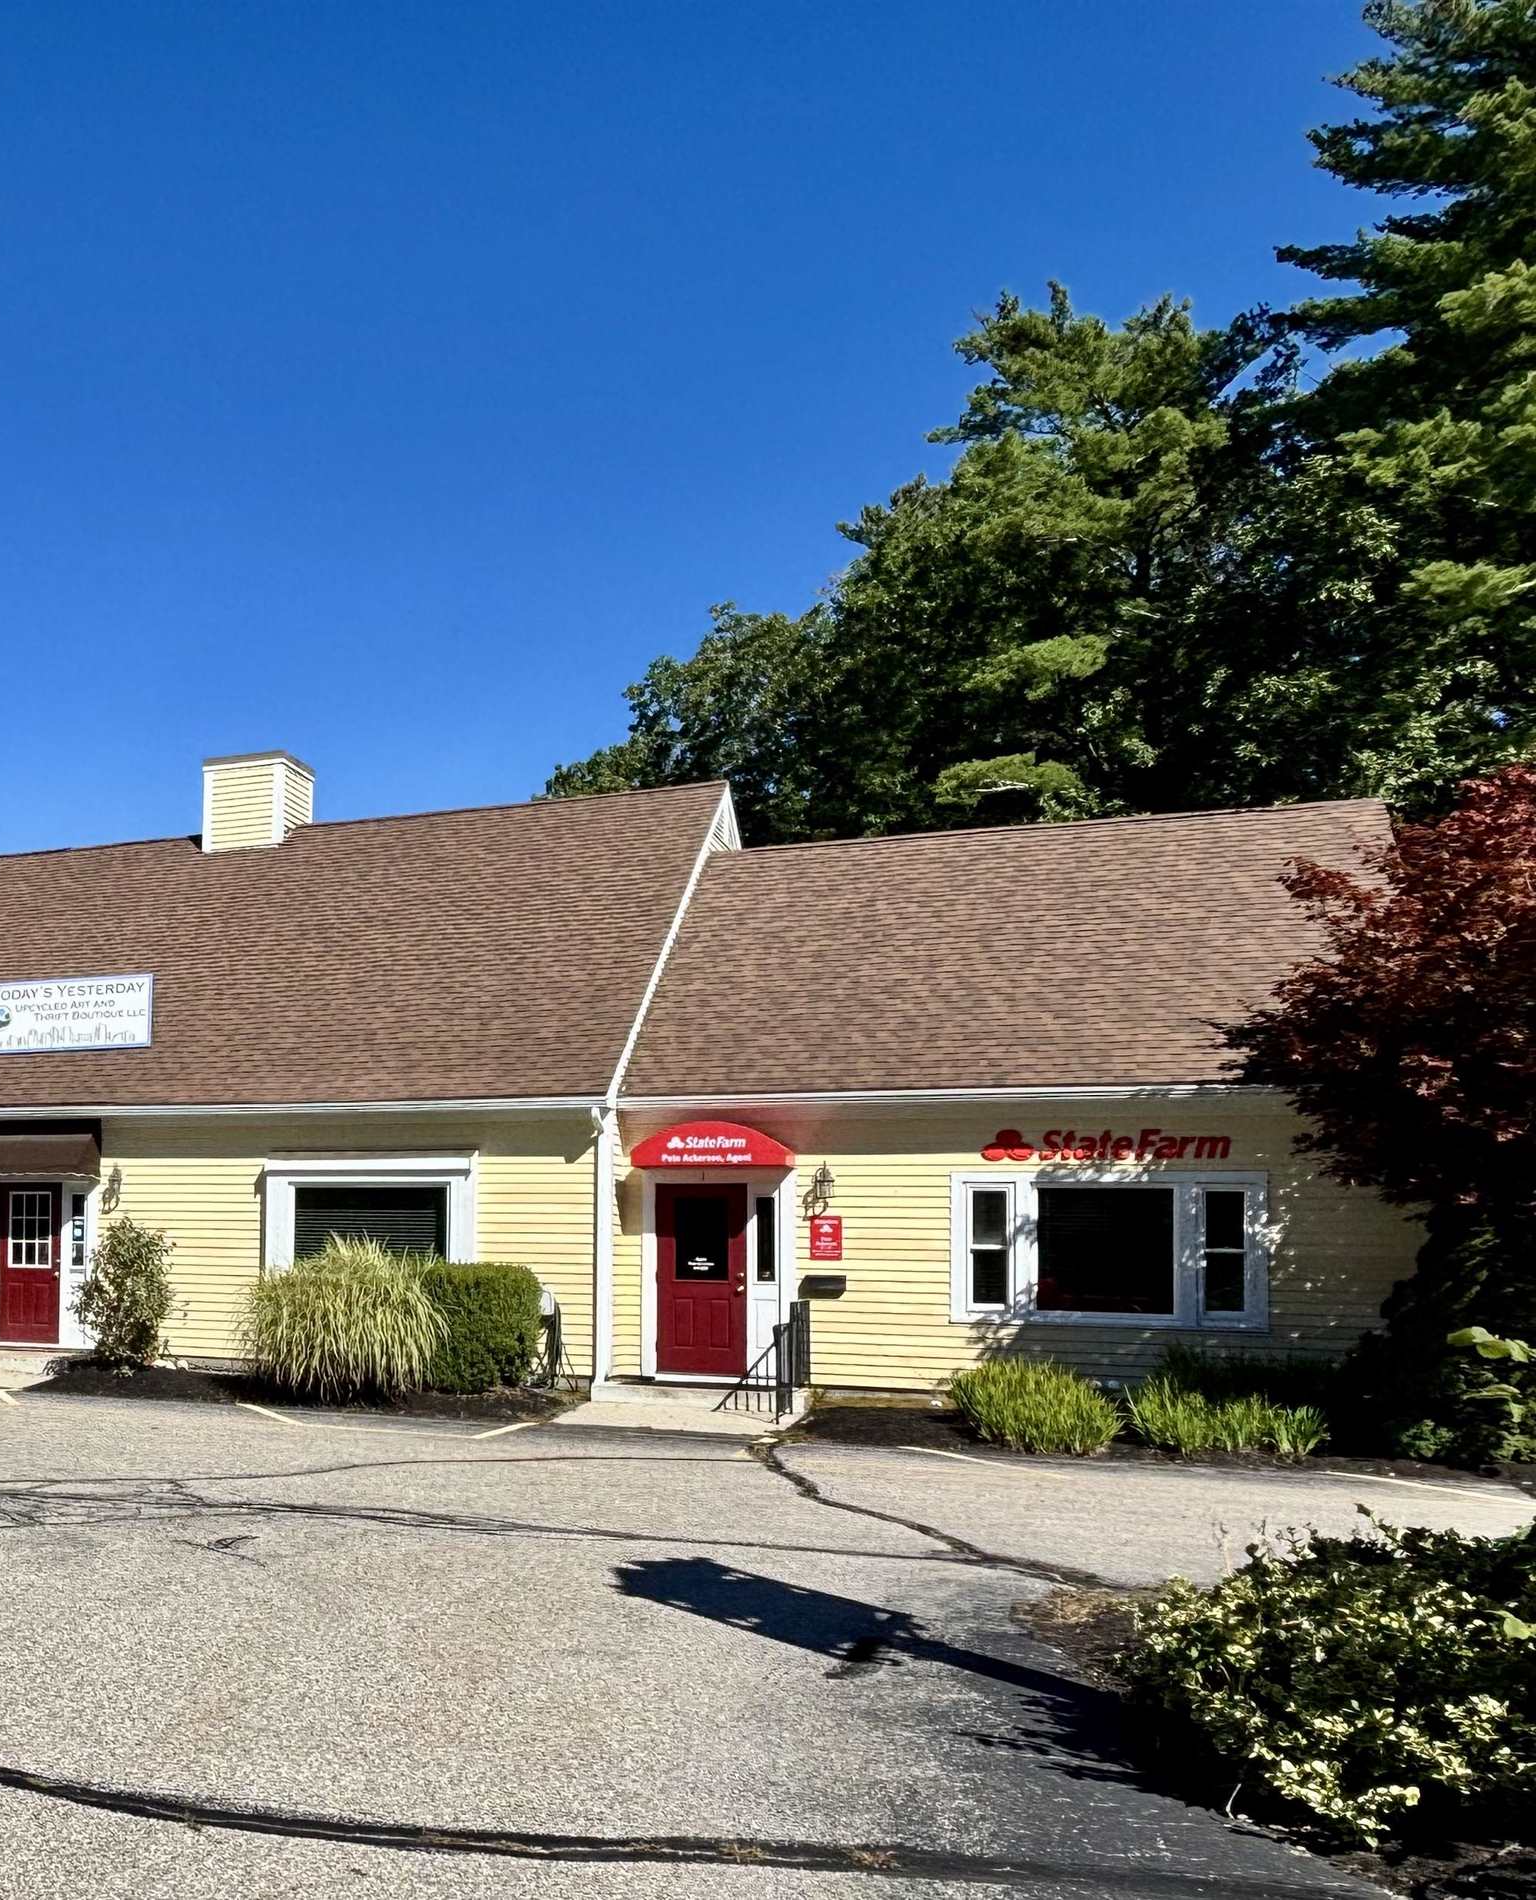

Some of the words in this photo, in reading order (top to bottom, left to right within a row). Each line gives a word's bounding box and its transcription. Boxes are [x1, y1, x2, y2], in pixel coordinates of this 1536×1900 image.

[57, 982, 145, 997] YESTERDAY
[15, 1001, 68, 1013] UPCYCLED
[70, 1000, 91, 1010] ART
[93, 999, 115, 1009] AND
[126, 1008, 146, 1018] LLC
